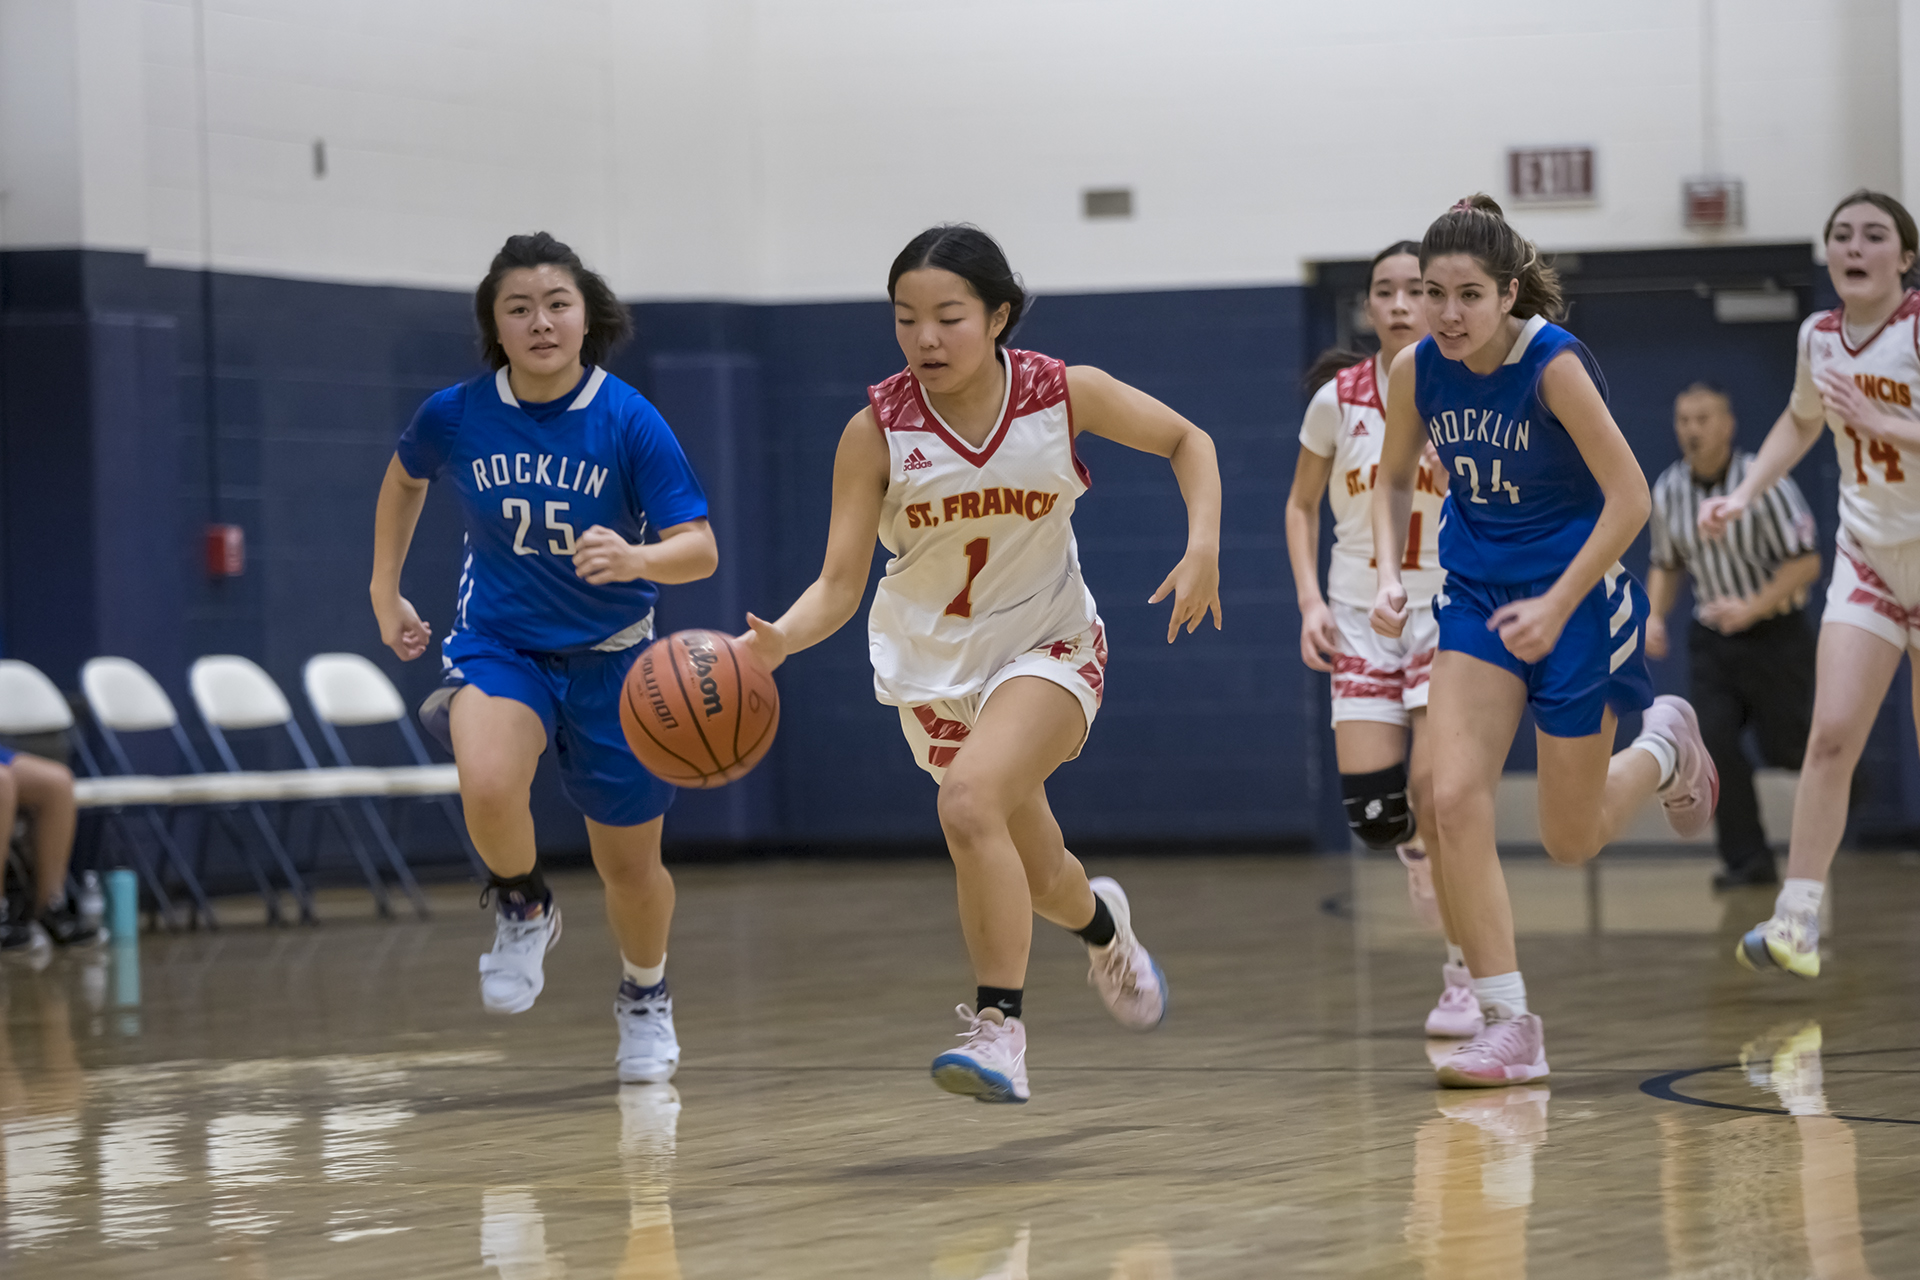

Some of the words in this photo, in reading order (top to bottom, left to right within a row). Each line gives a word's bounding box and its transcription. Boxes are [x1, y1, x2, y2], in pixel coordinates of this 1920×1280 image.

[1854, 373, 1912, 409] NCIS
[1429, 408, 1530, 451] ROCKLIN
[472, 453, 609, 498] ROCKLIN
[903, 460, 933, 472] adidas
[1844, 423, 1905, 485] 14
[1454, 456, 1520, 504] 24
[502, 498, 578, 556] 25
[943, 537, 991, 618] 1
[643, 650, 679, 730] VOLUTION
